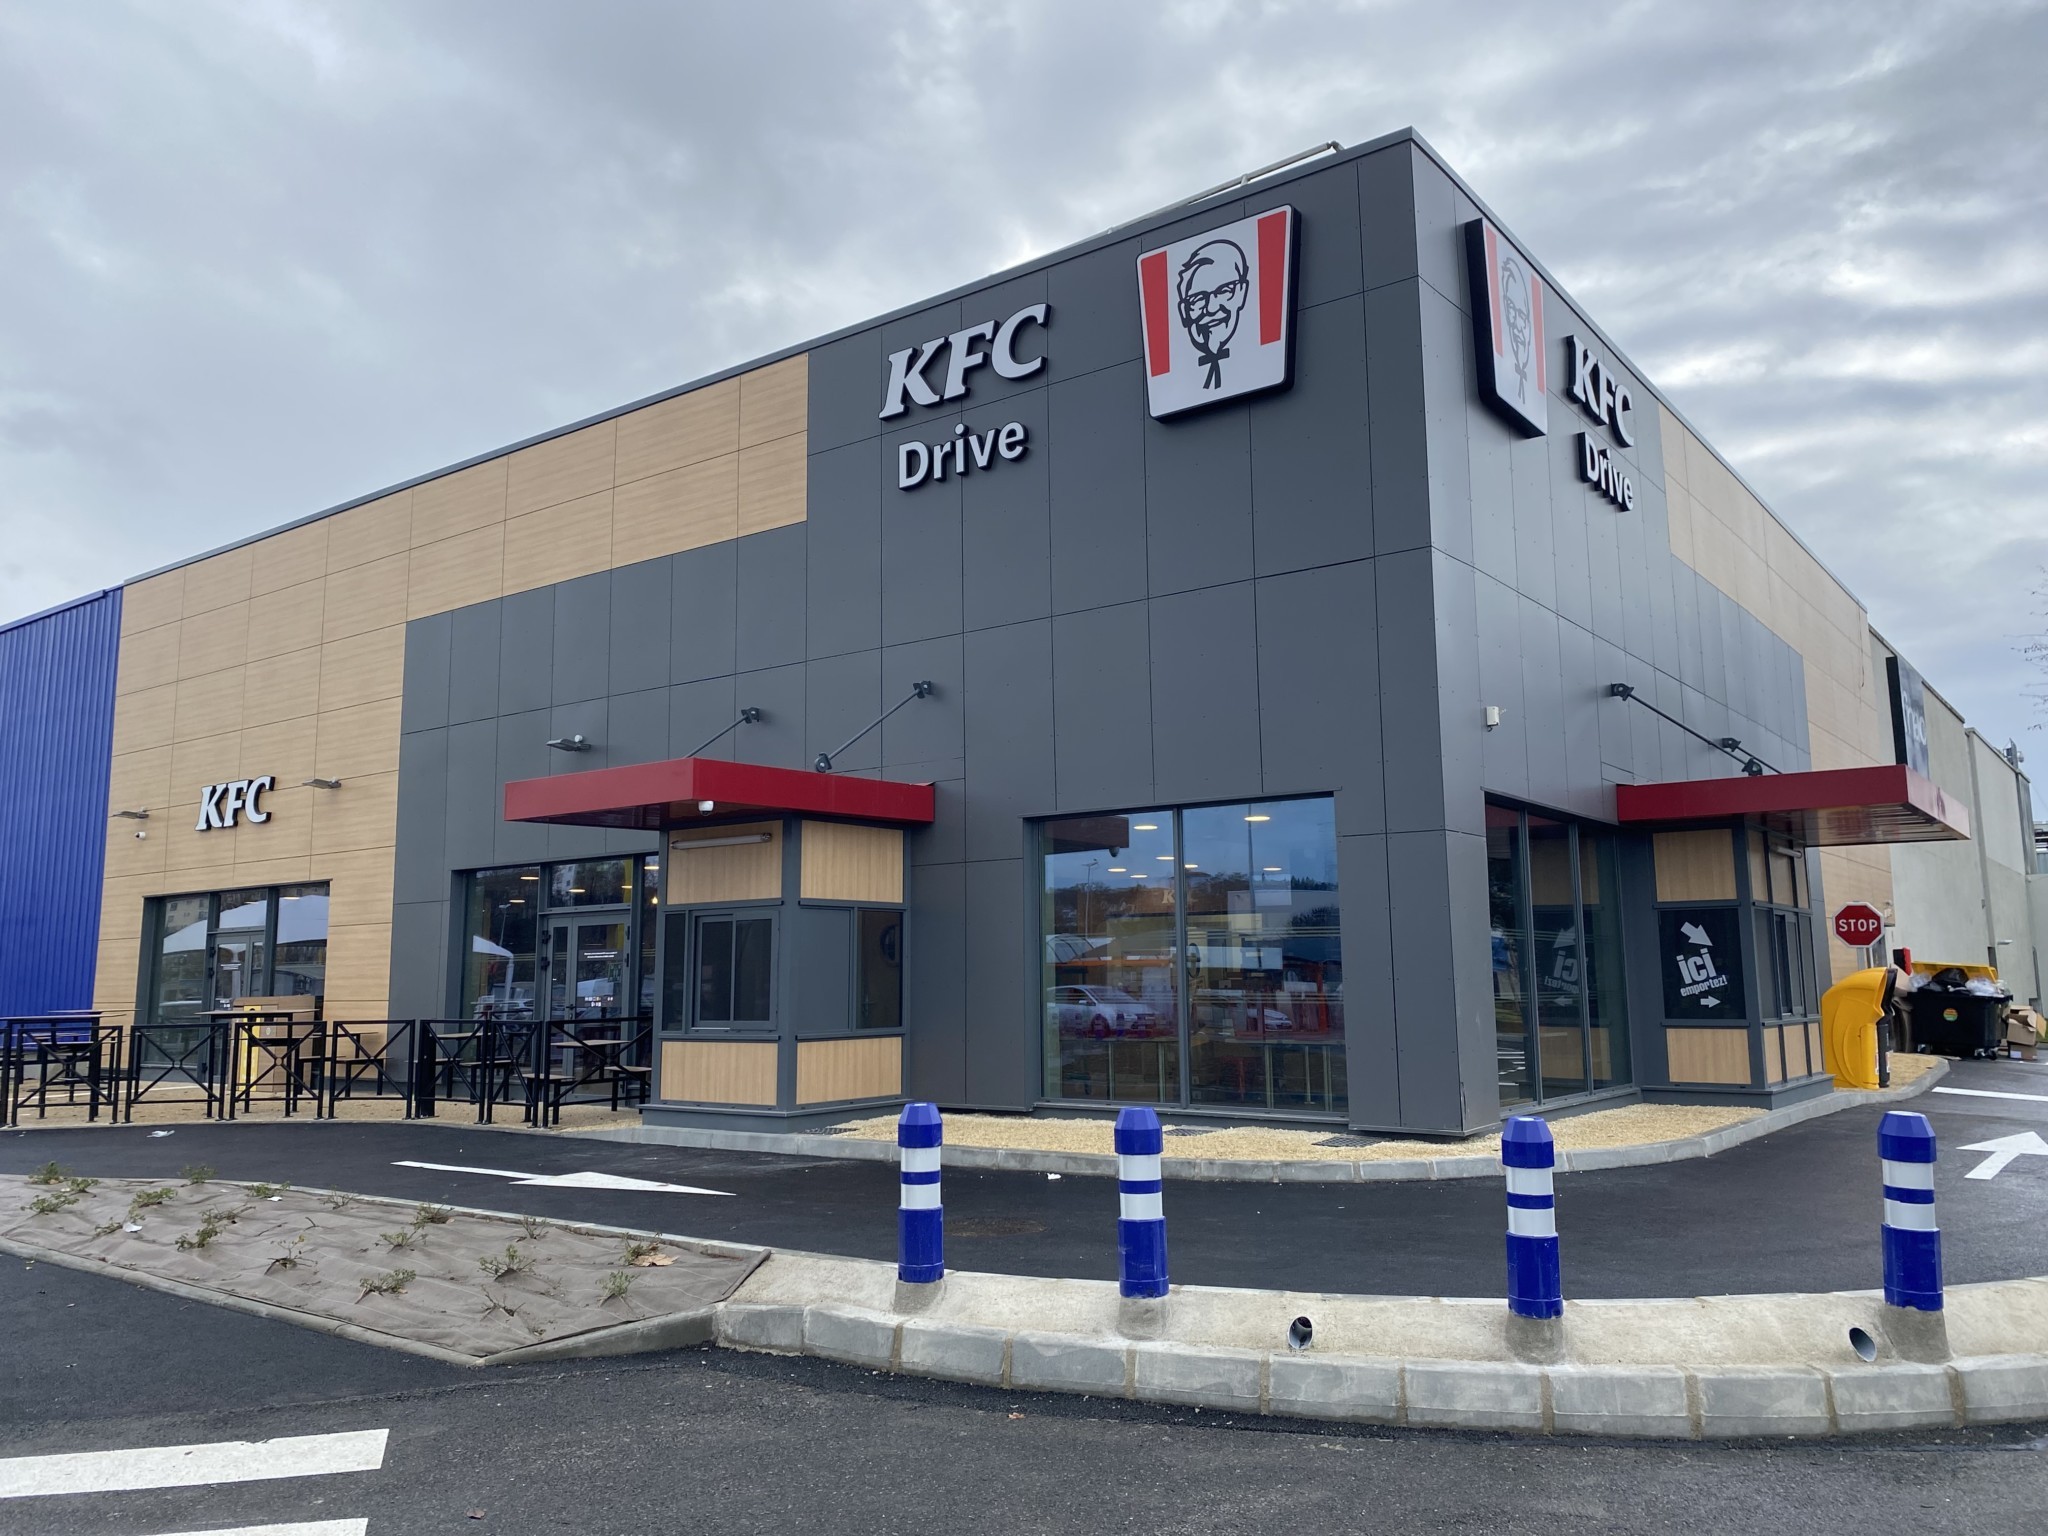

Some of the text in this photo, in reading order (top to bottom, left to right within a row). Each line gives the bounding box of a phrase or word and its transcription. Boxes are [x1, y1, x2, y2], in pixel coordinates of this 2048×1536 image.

[879, 303, 1050, 420] KFC
[1568, 334, 1635, 447] KFC
[899, 420, 1028, 490] Drive
[1579, 431, 1634, 512] Drive
[195, 775, 275, 831] KFC
[1838, 918, 1878, 932] STOP
[1676, 948, 1717, 985] ici
[1680, 974, 1728, 997] emportez!
